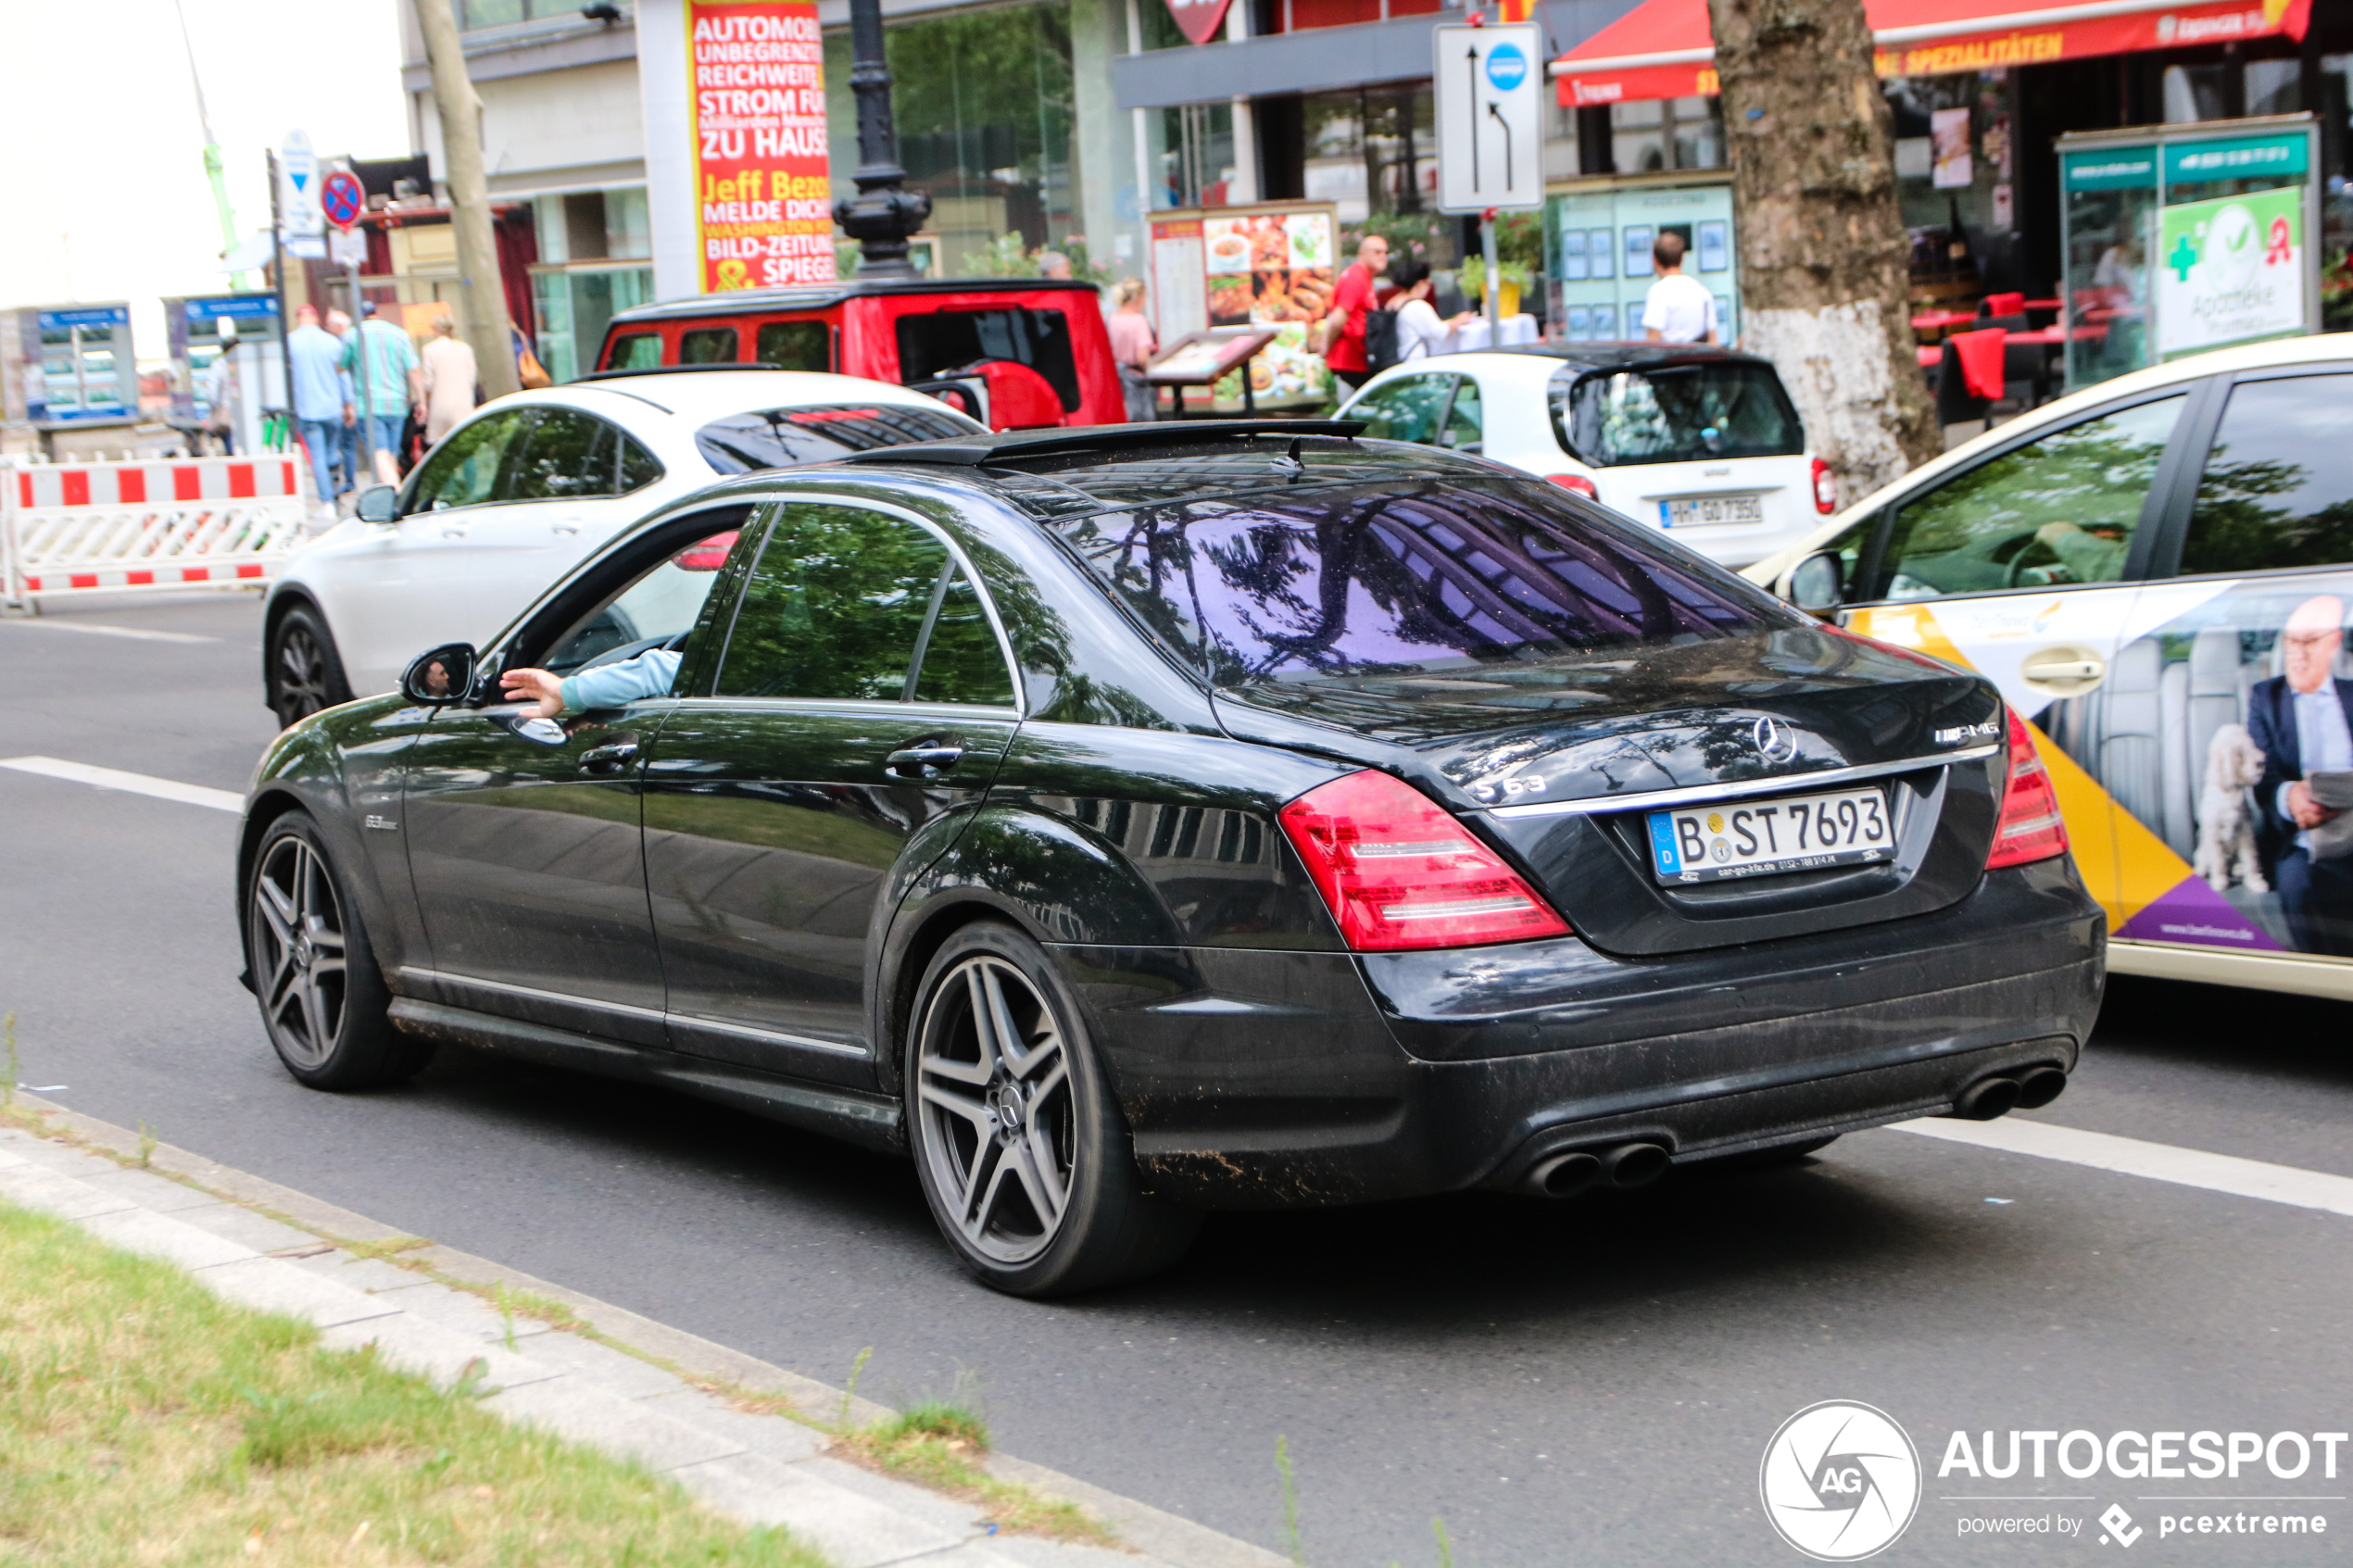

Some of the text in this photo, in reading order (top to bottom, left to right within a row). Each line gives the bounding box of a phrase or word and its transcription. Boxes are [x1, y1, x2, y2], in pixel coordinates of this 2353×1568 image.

[698, 89, 796, 116] STROM
[700, 128, 746, 159] ZU
[702, 169, 764, 203] Jeff
[702, 199, 783, 224] MELDE
[1475, 774, 1547, 798] S 63
[1676, 797, 1883, 863] B ST 7693
[1662, 849, 1673, 864] D
[1718, 861, 1777, 876] car-go-kfz.de
